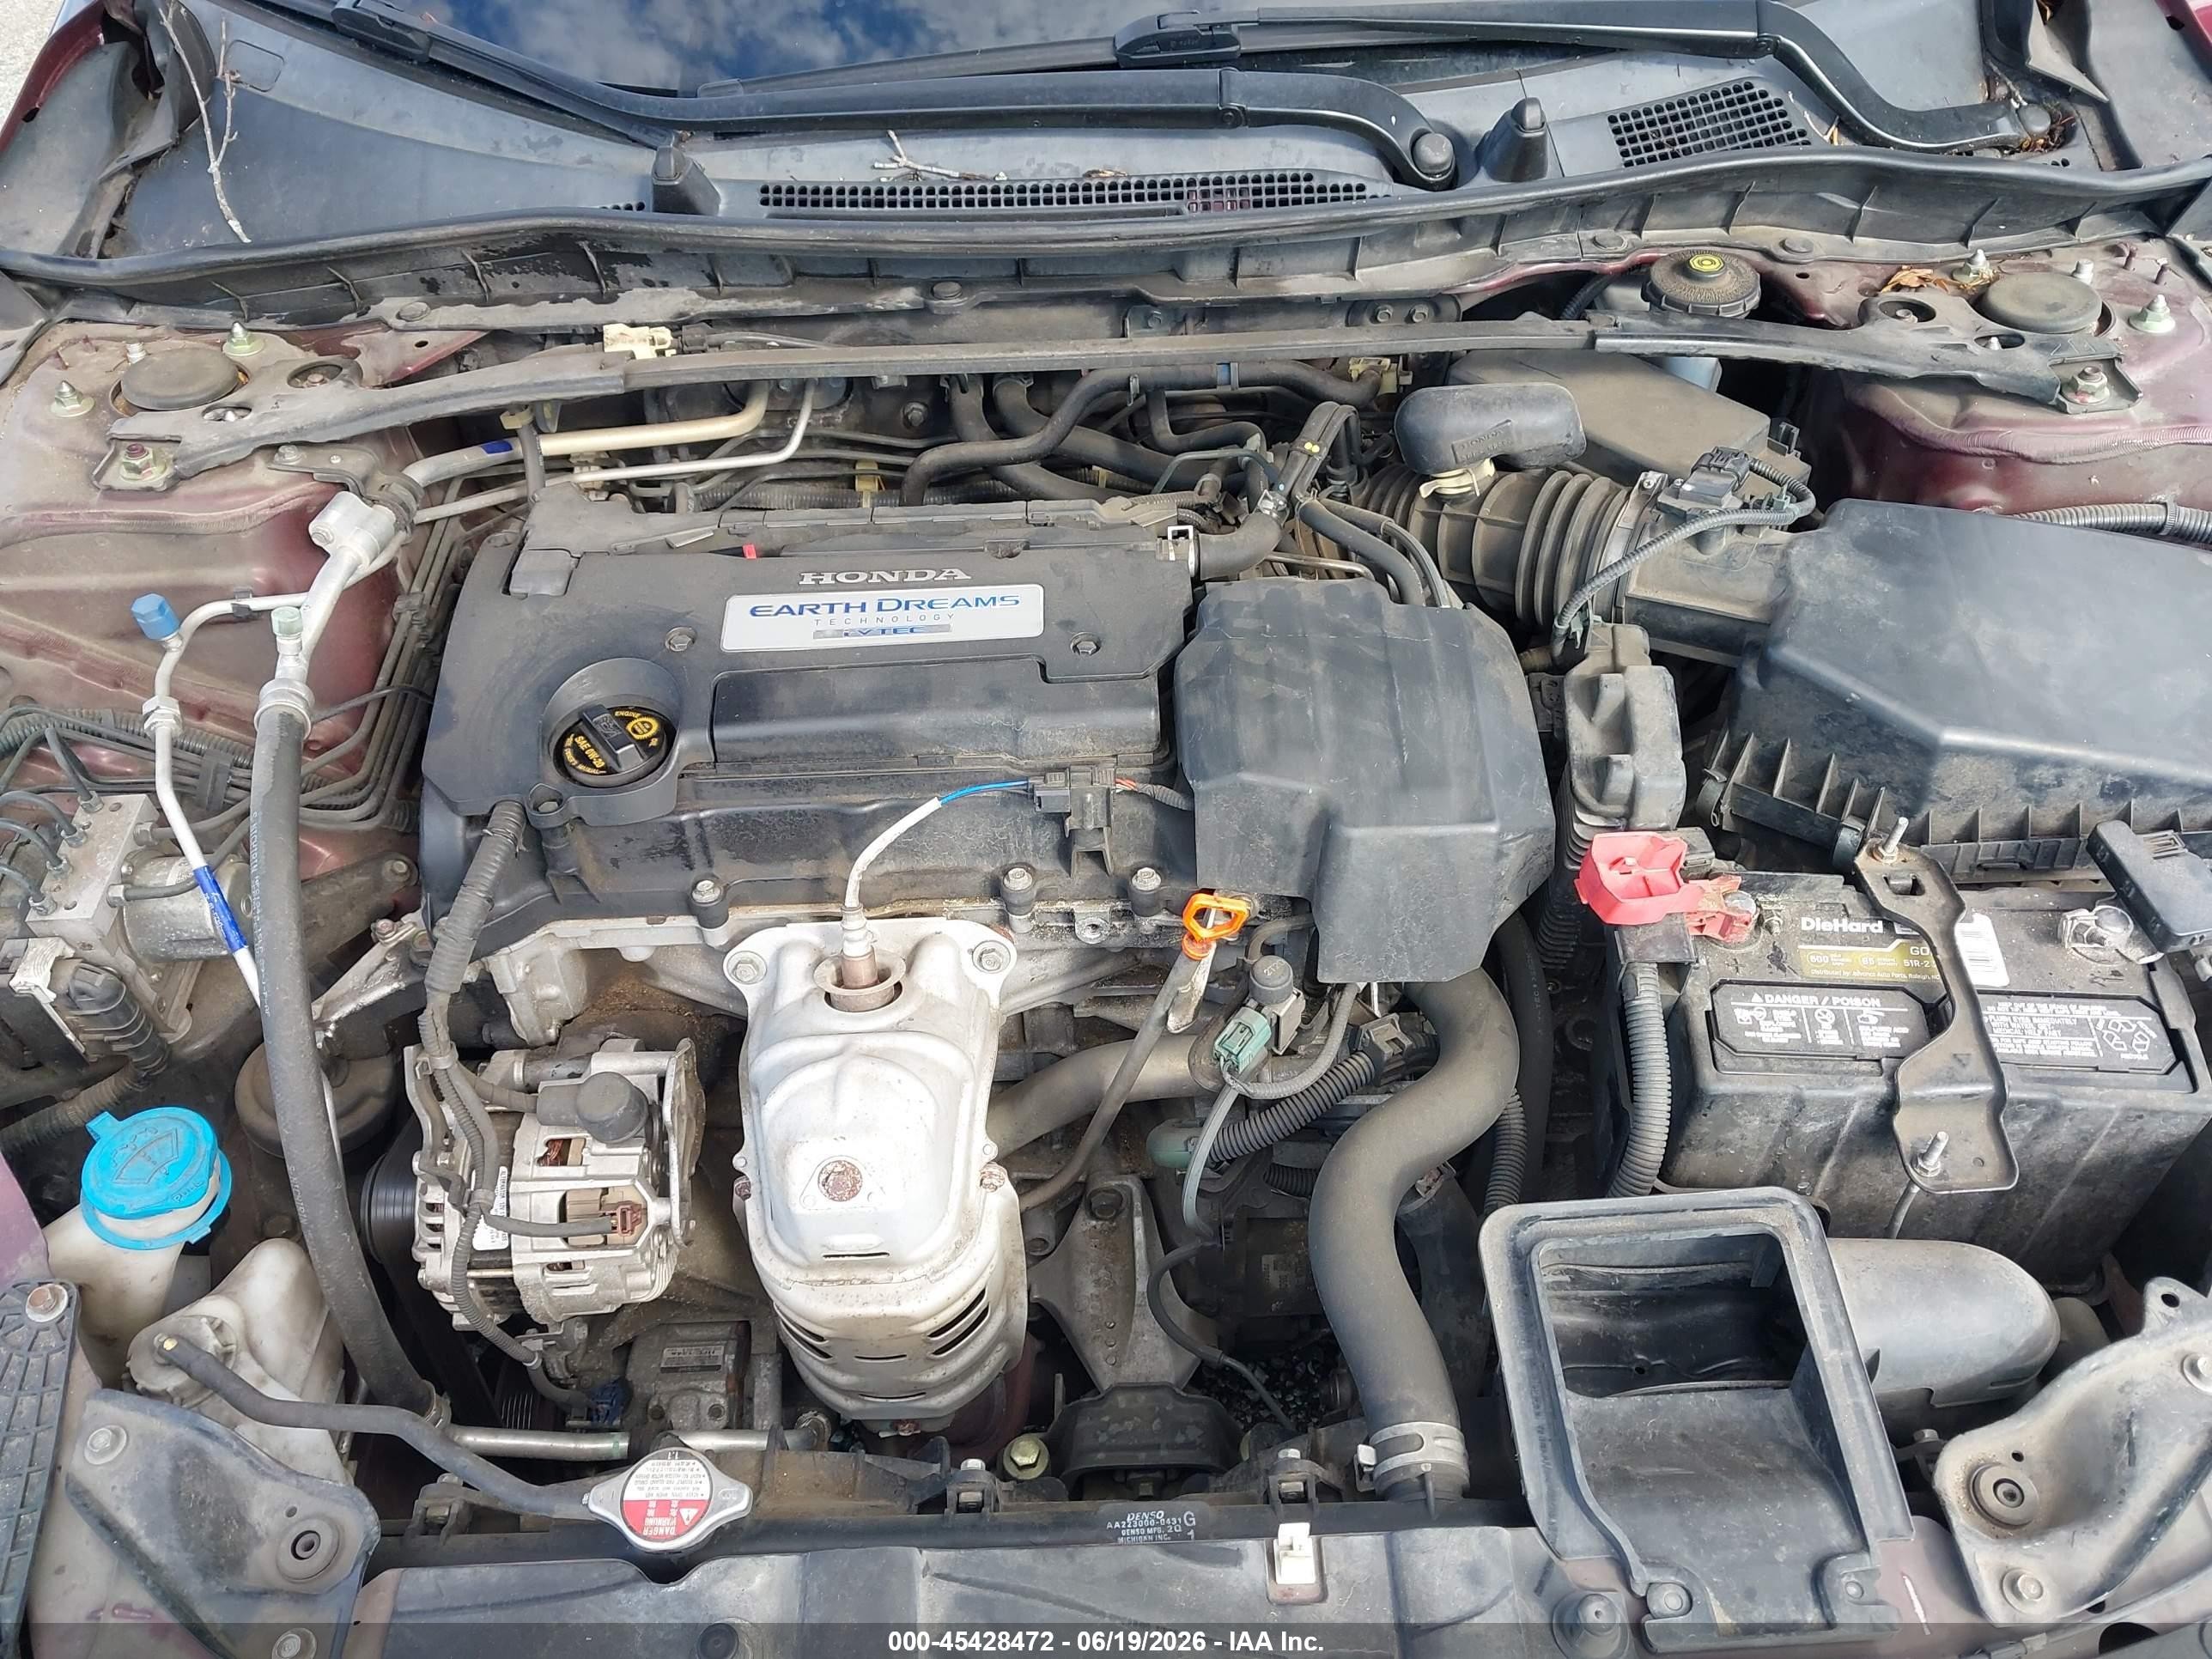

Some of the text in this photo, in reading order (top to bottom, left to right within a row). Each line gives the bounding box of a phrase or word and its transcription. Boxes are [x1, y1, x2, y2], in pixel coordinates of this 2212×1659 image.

[799, 568, 971, 586] HONDA
[749, 595, 1020, 617] EARTH DREAMS
[815, 613, 955, 627] TECHNOLOGY
[614, 710, 641, 720] ENGINE
[574, 735, 605, 769] SAE 0W-20
[1801, 917, 1884, 933] DieHard
[1910, 946, 1933, 956] GO
[1764, 994, 1819, 1005] DANGER
[1832, 996, 1881, 1007] POISON
[667, 1451, 679, 1460] 1.1
[1127, 1510, 1164, 1522] DENSO
[642, 1526, 677, 1536] DANGER
[1121, 1528, 1146, 1536] DENSO
[1117, 1535, 1153, 1544] MICHIGAN
